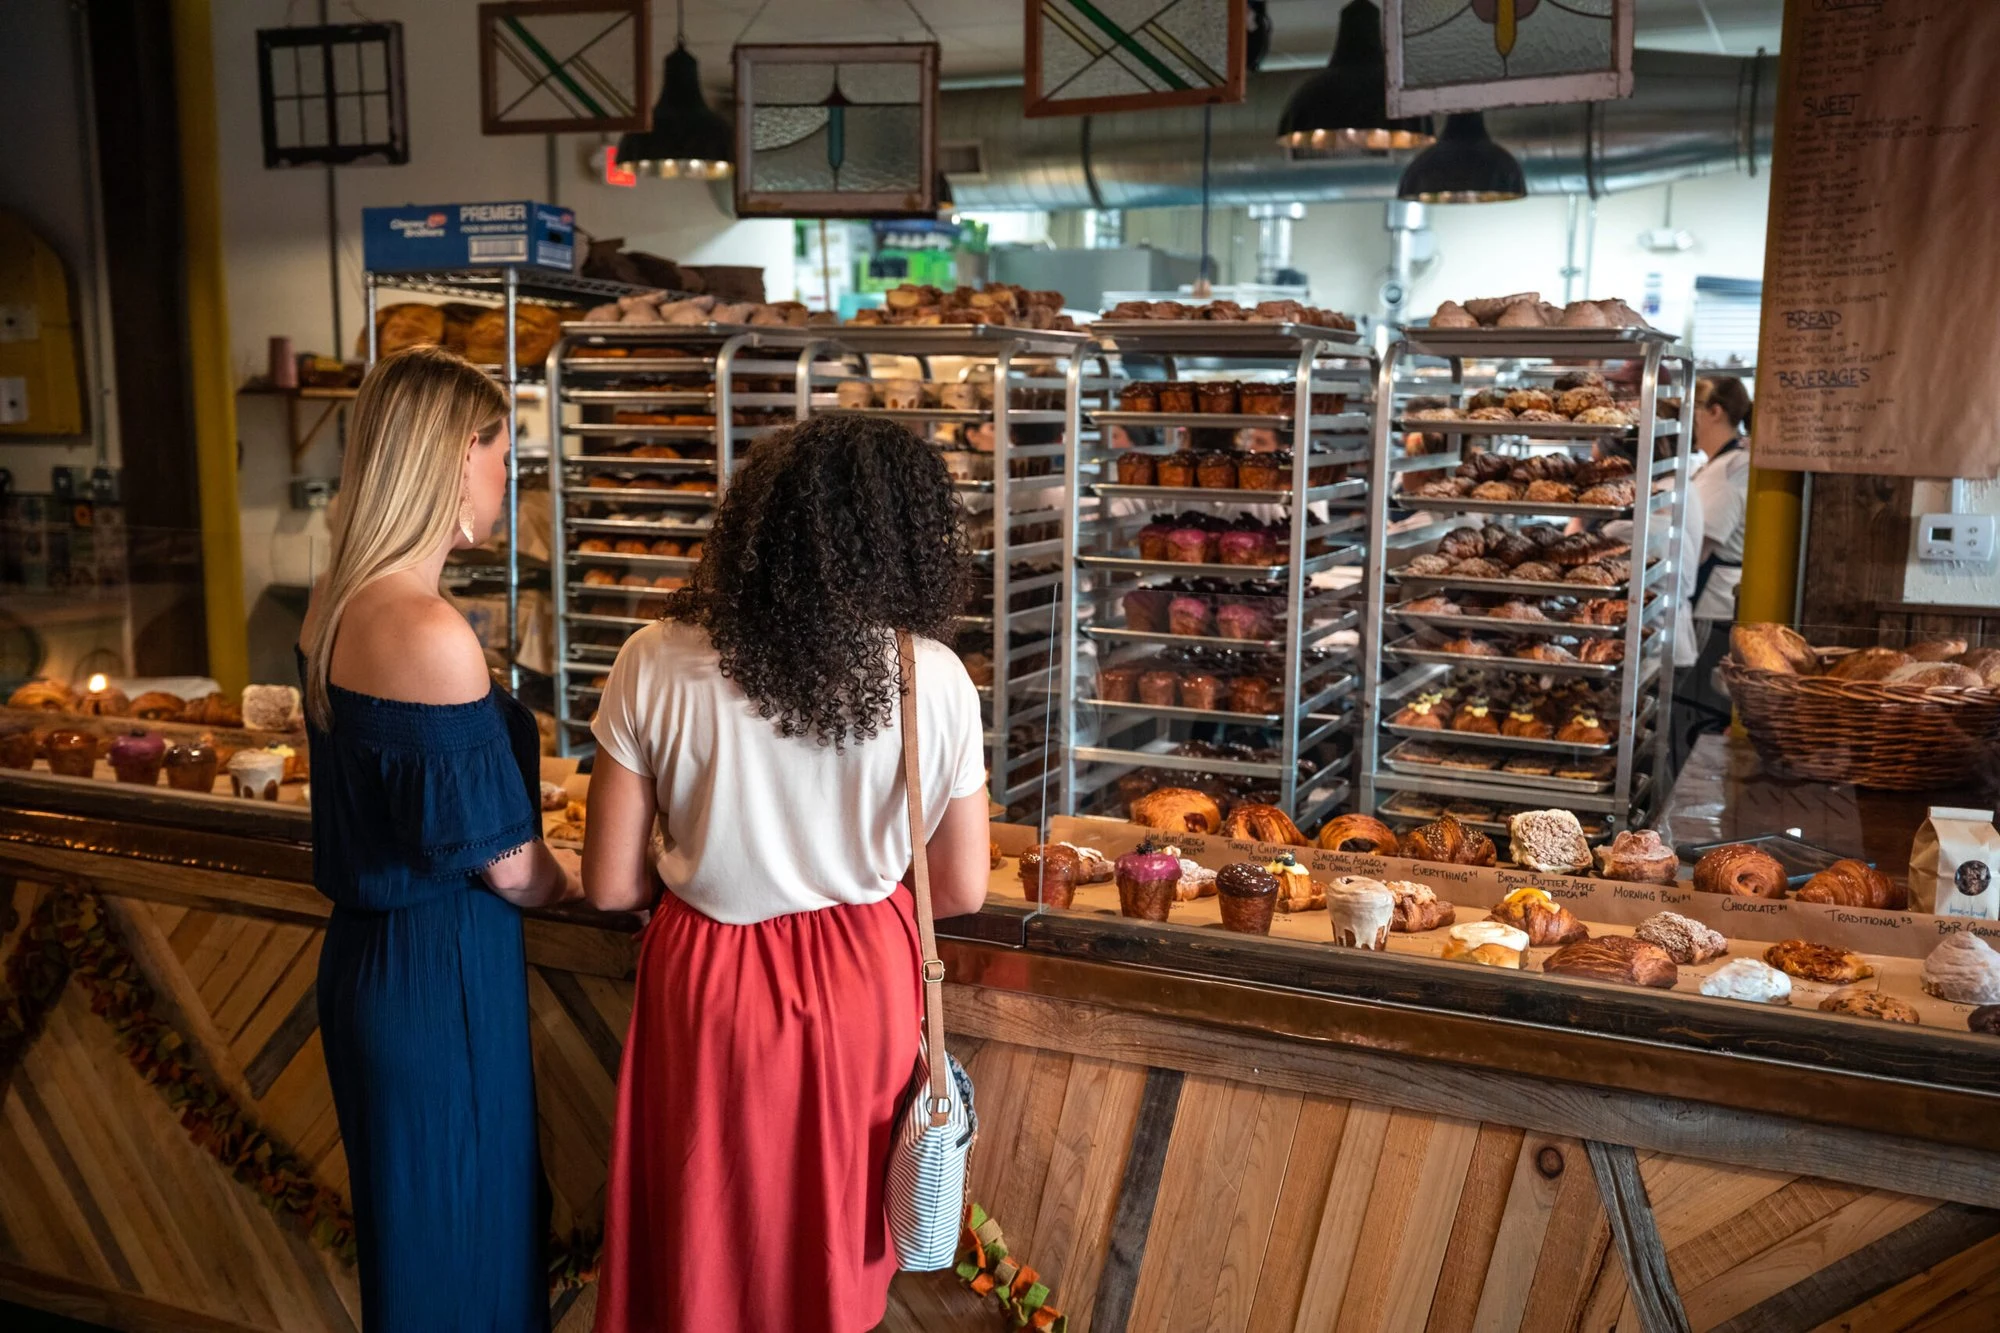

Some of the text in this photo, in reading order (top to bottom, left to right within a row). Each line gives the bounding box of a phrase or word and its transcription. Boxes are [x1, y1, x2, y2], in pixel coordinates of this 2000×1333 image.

[1803, 94, 1861, 114] SWEET
[459, 204, 528, 222] PREMIER
[1781, 309, 1842, 329] BREAD
[1775, 368, 1870, 388] BEVERAGES
[1225, 839, 1254, 855] TURKEY
[1329, 862, 1352, 873] ONION
[1411, 863, 1468, 883] EVERYTHING
[1494, 871, 1527, 884] BROWN
[1529, 873, 1569, 888] BUTTER
[1571, 879, 1597, 892] APPLE
[1613, 885, 1656, 902] MORNING
[1660, 890, 1681, 904] BUN
[1721, 897, 1778, 915] CHOCOLATE
[1824, 909, 1900, 928] TRADITIONAL
